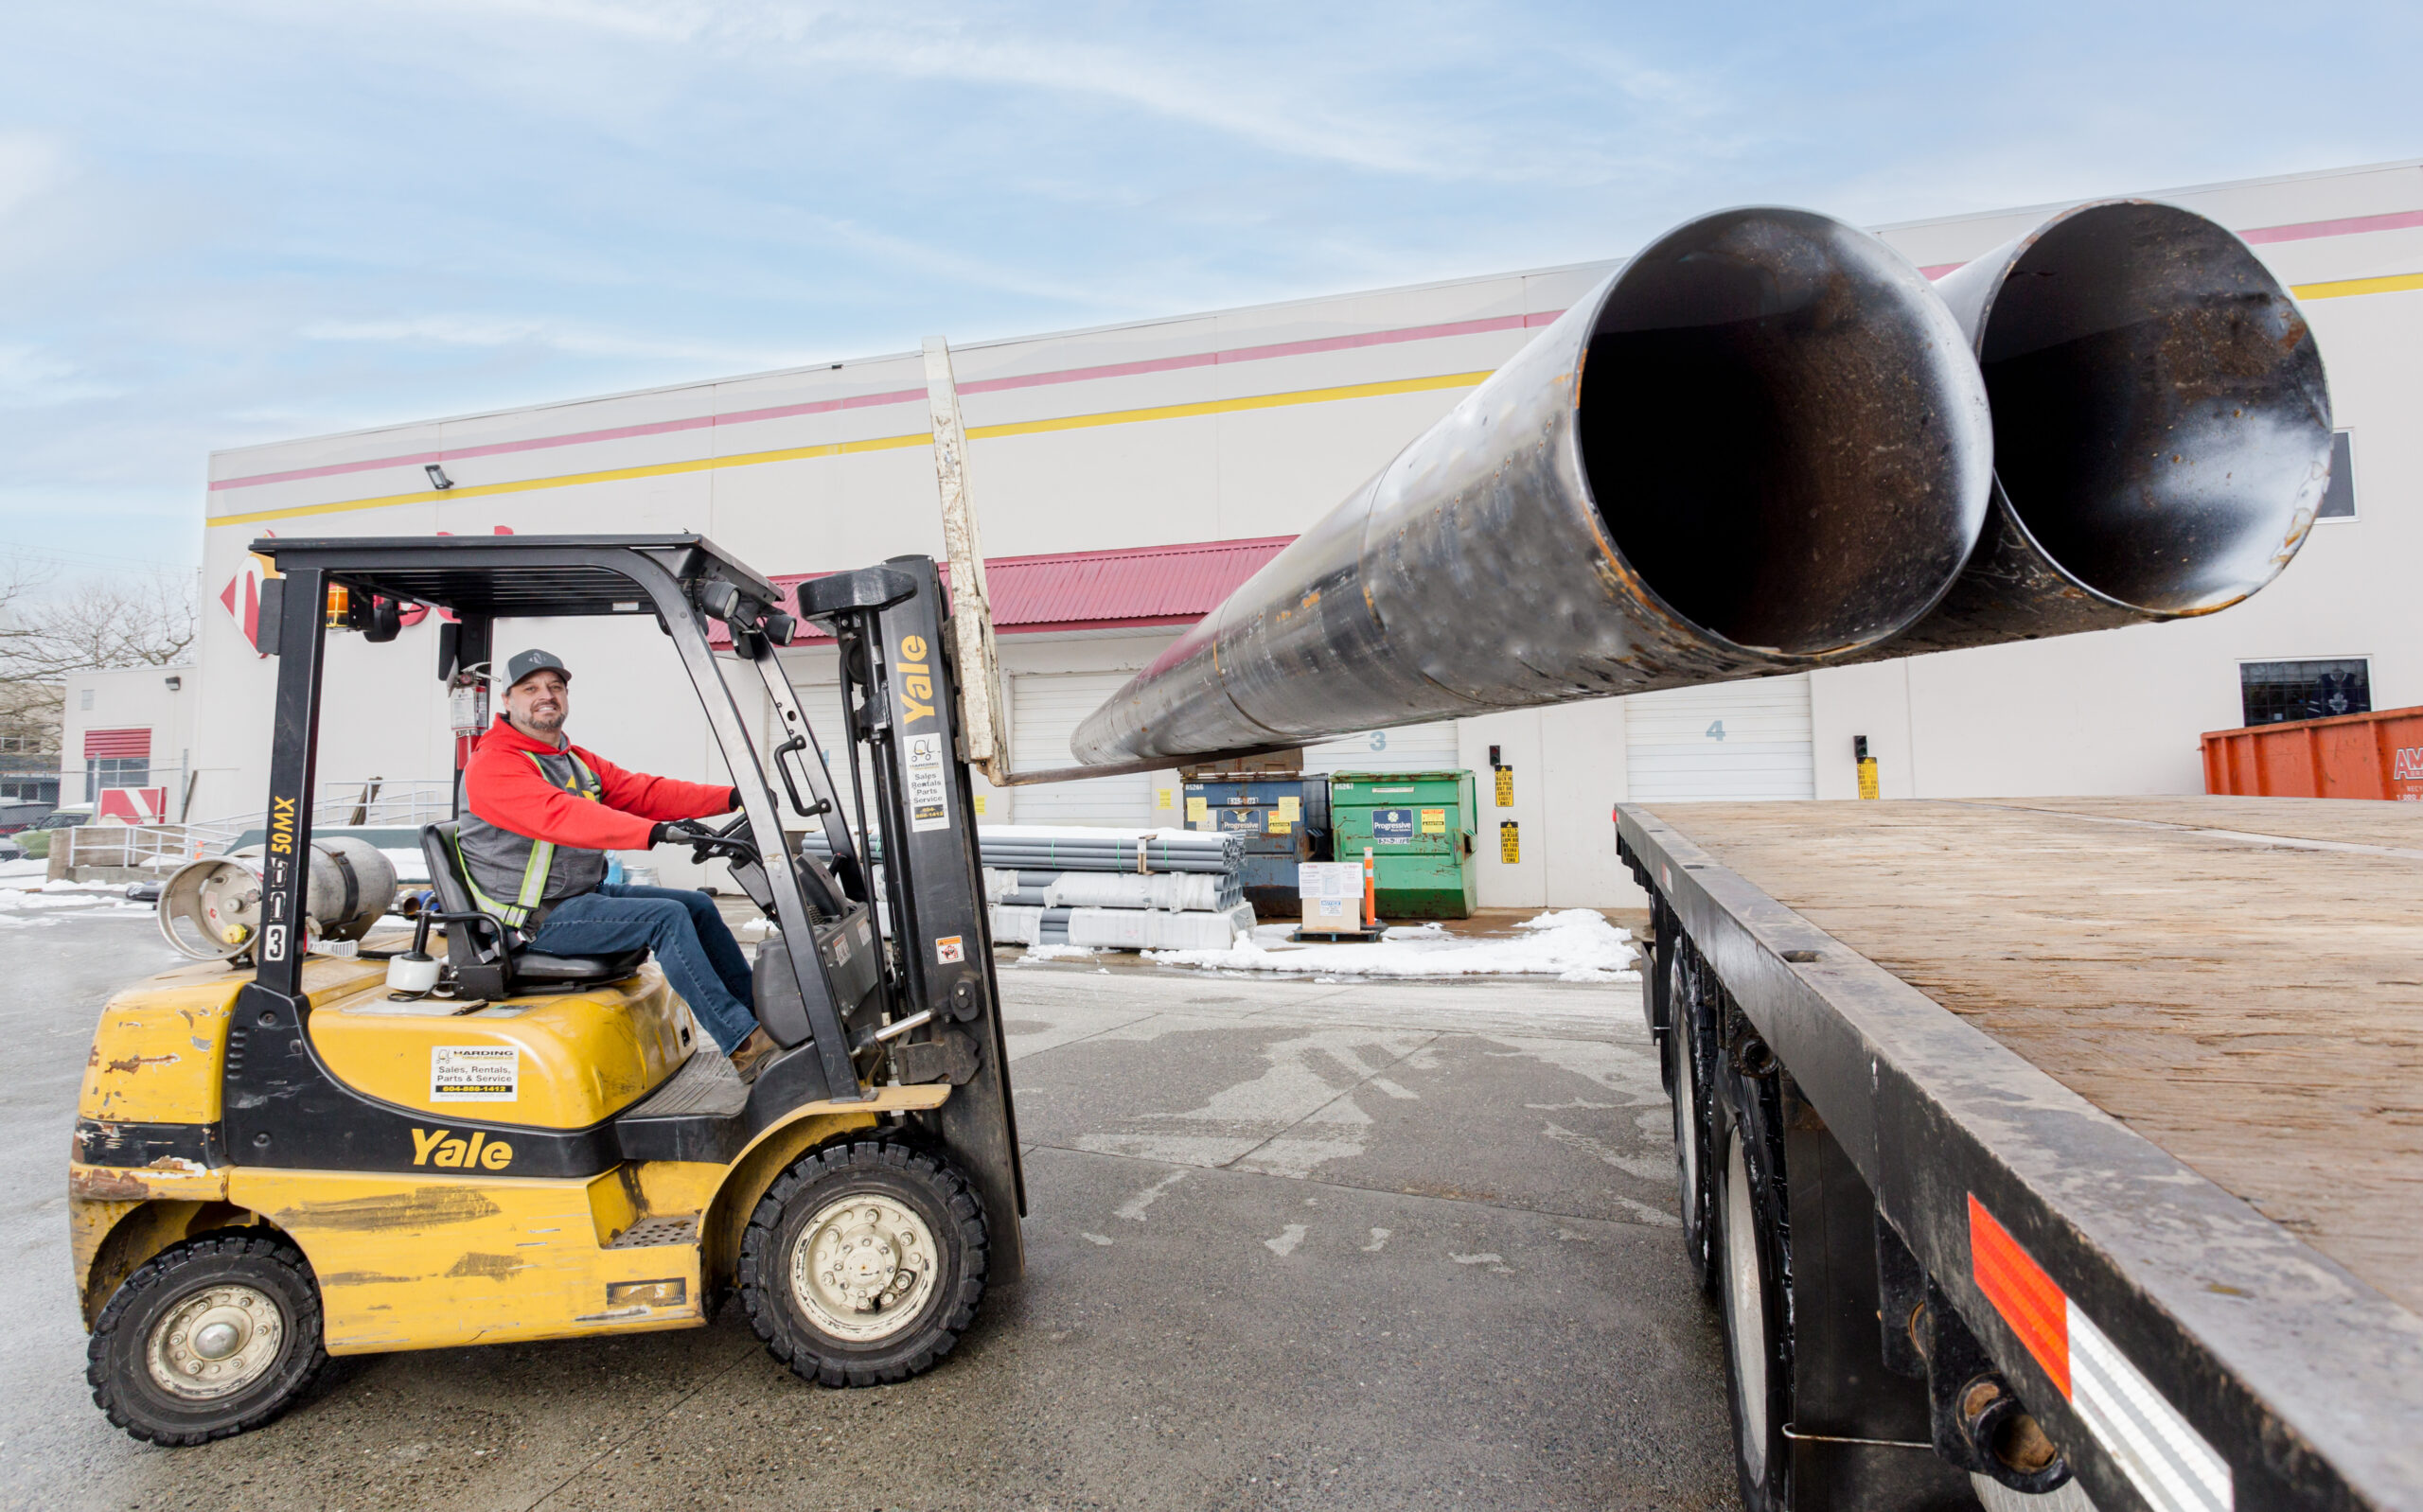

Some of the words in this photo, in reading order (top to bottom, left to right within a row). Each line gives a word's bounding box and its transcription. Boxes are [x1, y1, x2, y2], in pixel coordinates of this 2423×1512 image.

[896, 635, 935, 725] Yale
[1370, 731, 1387, 751] 3
[1706, 720, 1725, 742] 4
[913, 796, 943, 804] Service
[271, 796, 295, 854] 50MX
[1224, 821, 1259, 831] Progressive
[1374, 821, 1411, 831] Progressive
[438, 1066, 469, 1075] Sales,
[412, 1129, 513, 1170] Yale
